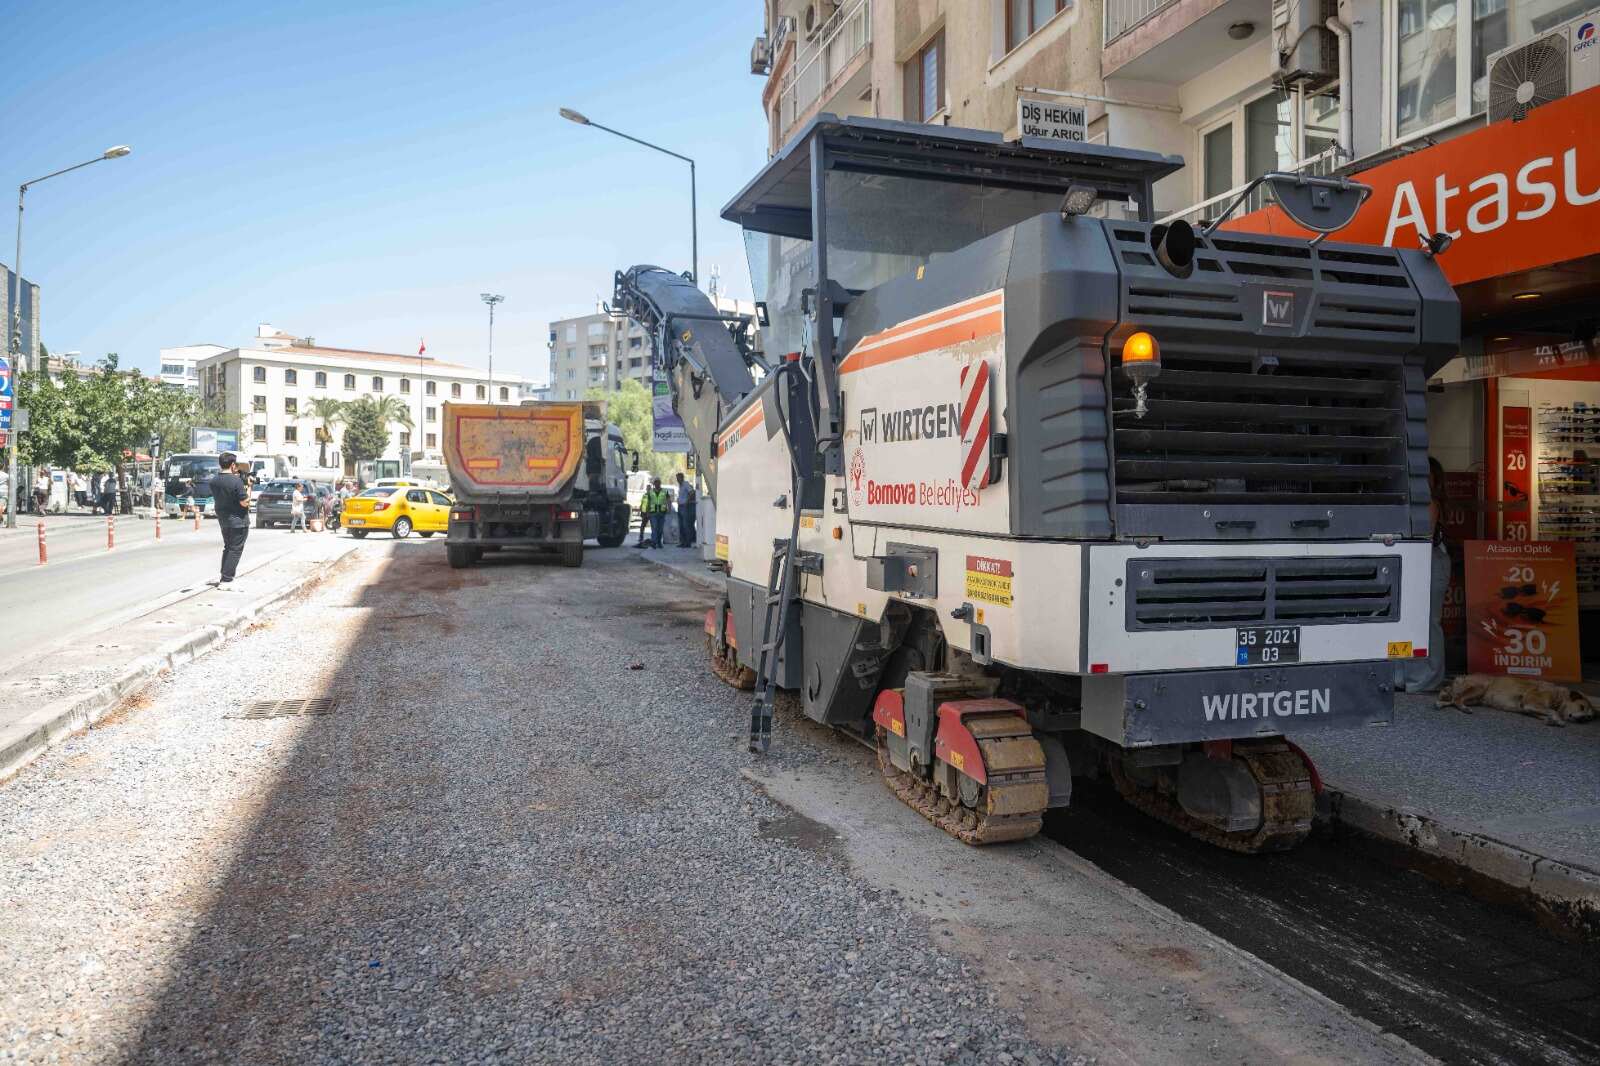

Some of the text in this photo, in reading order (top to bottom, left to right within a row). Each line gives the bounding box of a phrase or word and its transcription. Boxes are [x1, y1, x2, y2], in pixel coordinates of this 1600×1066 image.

[1022, 103, 1085, 127] DİŞ HEKİMİ
[1023, 124, 1049, 137] Uğur
[881, 402, 962, 443] WIRTGEN
[1507, 453, 1526, 471] 20
[867, 478, 980, 513] Bornova Belediyesi
[1487, 544, 1552, 555] Atasun Optik
[1239, 629, 1297, 645] 35 2021
[1262, 647, 1279, 662] 03
[1202, 688, 1330, 721] WIRTGEN
